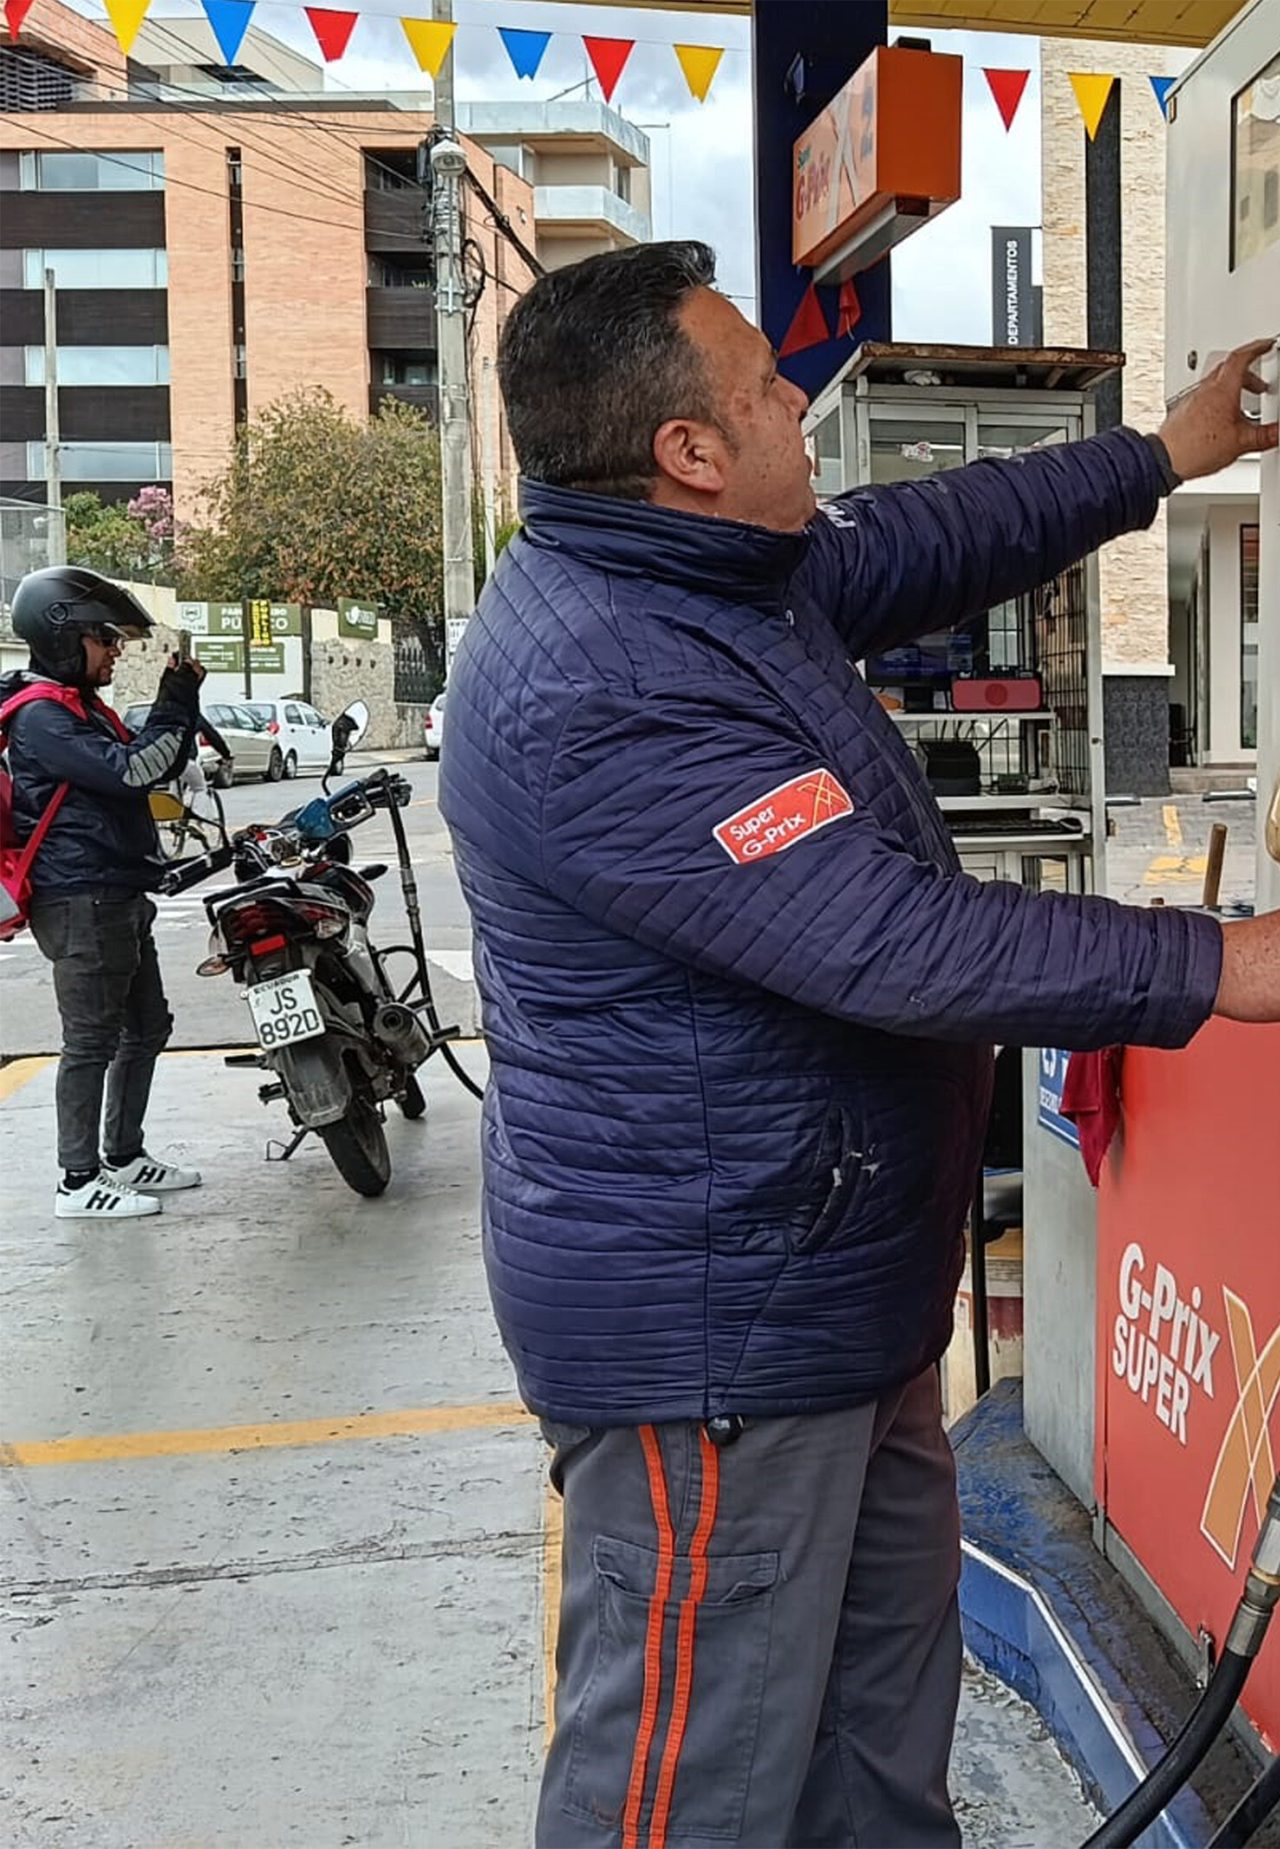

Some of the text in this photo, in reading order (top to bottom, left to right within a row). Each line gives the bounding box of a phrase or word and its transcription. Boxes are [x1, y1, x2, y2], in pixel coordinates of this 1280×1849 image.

[1007, 240, 1018, 345] DEPARTAMENTOS
[729, 806, 776, 841] Super
[742, 813, 807, 856] G-Prix
[270, 987, 298, 1015] JS
[260, 1008, 320, 1045] 892D
[131, 1165, 168, 1184] HI
[85, 1189, 121, 1210] HI
[1118, 1242, 1221, 1399] G-Prix
[1112, 1314, 1190, 1446] SUPER
